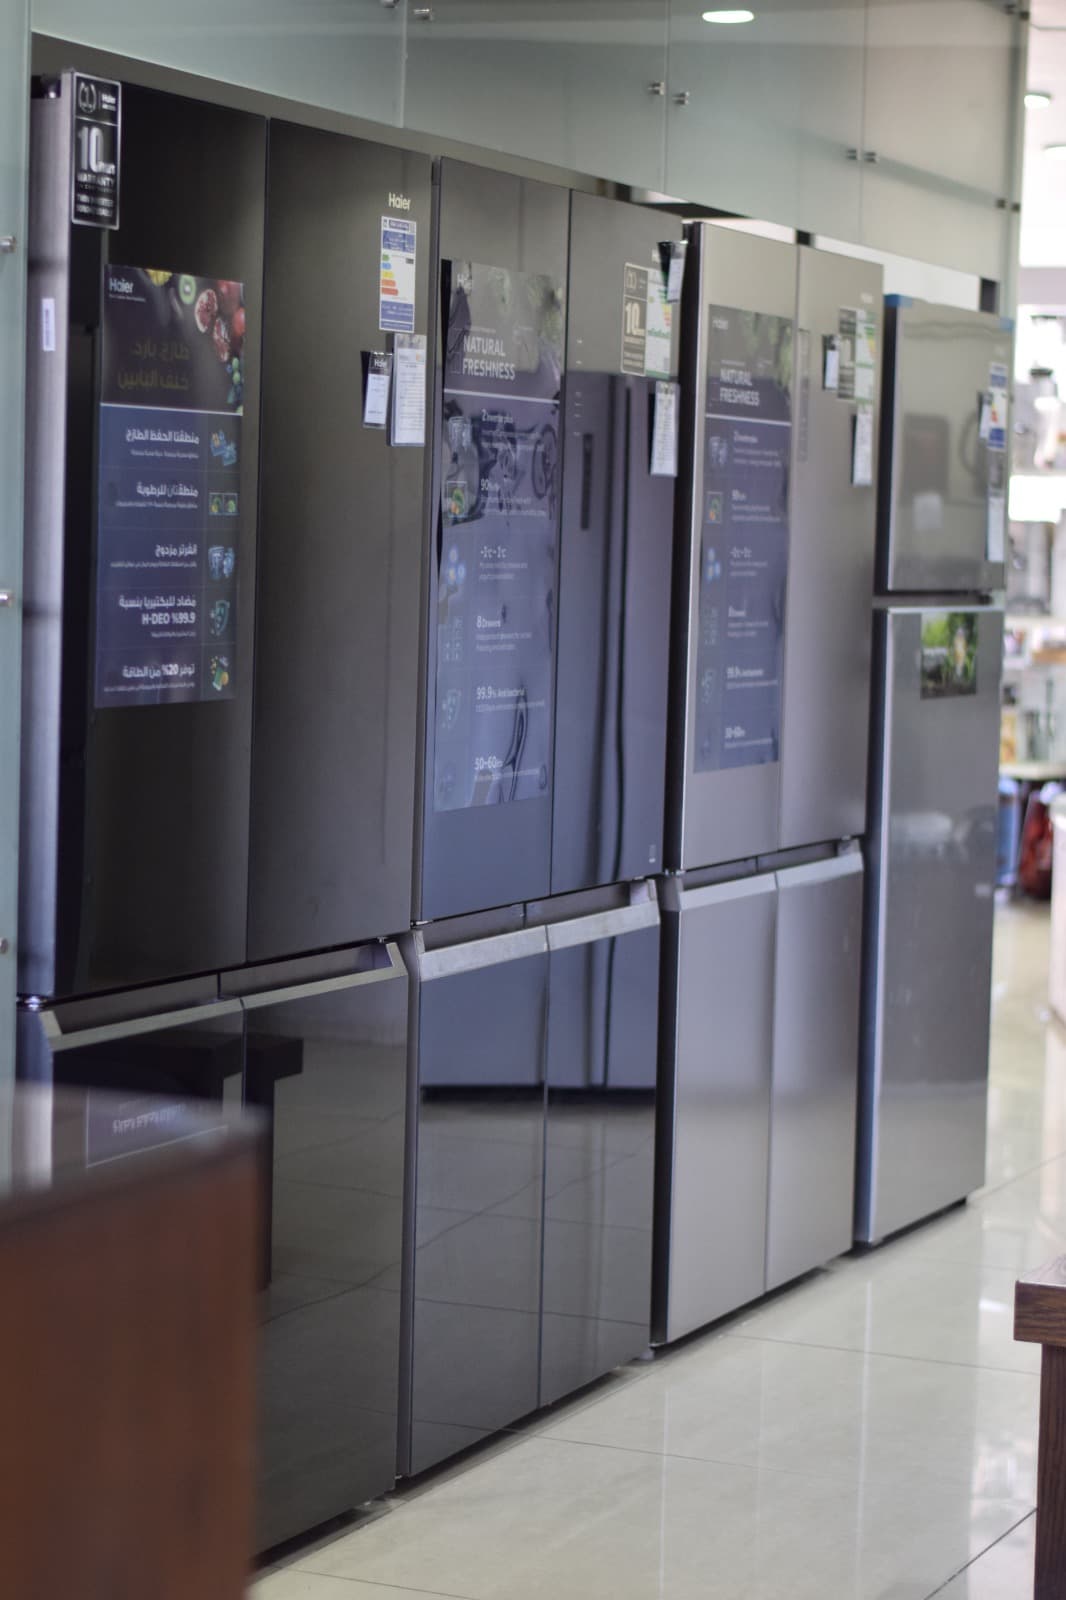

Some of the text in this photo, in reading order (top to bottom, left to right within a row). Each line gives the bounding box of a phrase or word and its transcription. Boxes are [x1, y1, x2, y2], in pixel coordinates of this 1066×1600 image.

[388, 192, 412, 210] Haier
[109, 277, 134, 293] Haier
[463, 334, 507, 357] NATURAL
[462, 357, 517, 381] FRESHNESS
[142, 612, 171, 625] H-DEO
